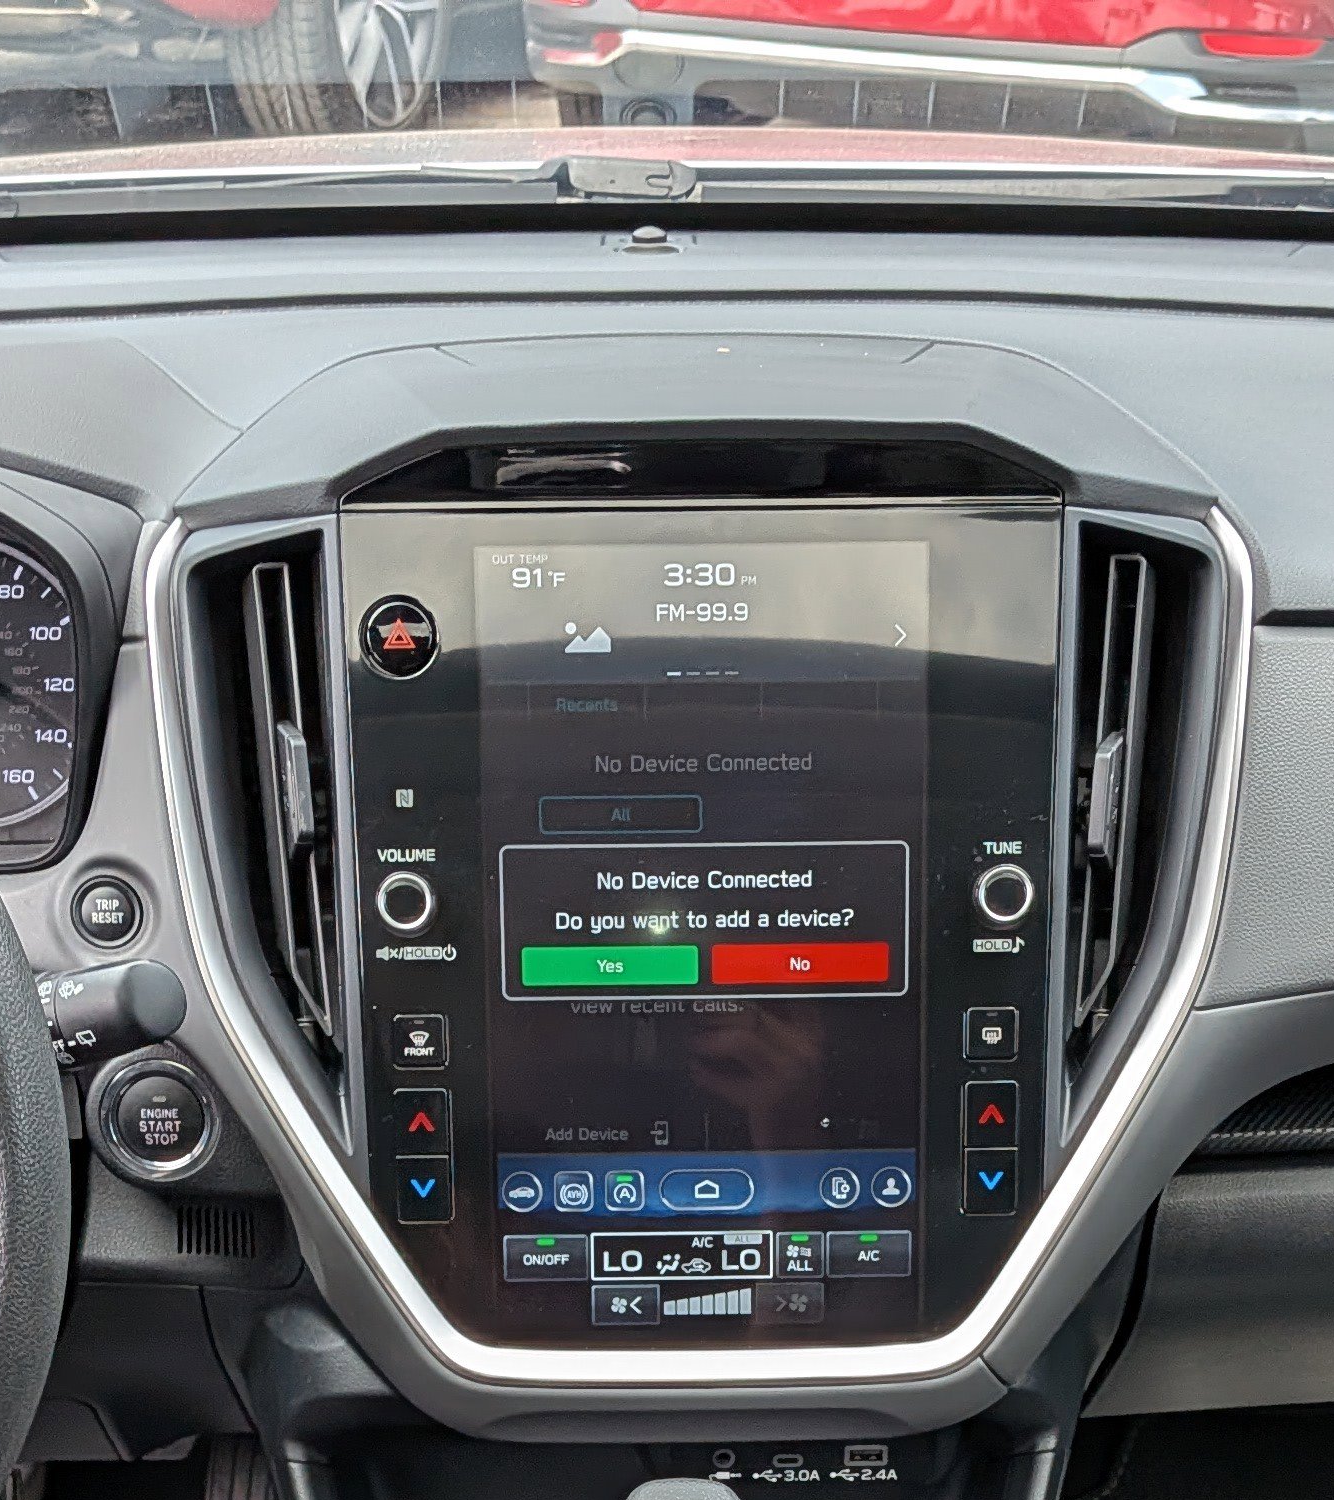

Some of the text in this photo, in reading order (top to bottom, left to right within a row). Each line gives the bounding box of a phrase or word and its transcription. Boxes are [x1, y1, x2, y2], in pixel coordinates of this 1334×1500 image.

[492, 553, 548, 565] OUT TEMP
[511, 568, 566, 589] 91°F
[663, 562, 757, 588] 3:30 PM
[655, 602, 749, 623] FM-99.9
[29, 627, 62, 641] 100
[43, 677, 76, 693] 120
[555, 697, 618, 712] Recents
[34, 729, 68, 744] 140
[595, 752, 812, 772] No Device Connected
[2, 769, 35, 784] 160
[610, 808, 631, 823] All
[983, 841, 1023, 855] TUNE
[377, 849, 436, 862] VOLUME
[596, 869, 813, 890] No Device Connected
[95, 898, 120, 911] TRIP
[91, 911, 124, 925] RESET
[555, 908, 854, 934] Do you want to add a device?
[404, 947, 442, 959] HOLD
[974, 940, 1011, 952] HOLD
[596, 960, 624, 973] Yes
[789, 957, 811, 971] No
[403, 1046, 435, 1058] FRONT
[140, 1107, 179, 1119] ENGINE
[139, 1120, 181, 1132] START
[144, 1133, 179, 1146] STOP
[544, 1127, 629, 1142] Add Device
[691, 1236, 714, 1248] A/C
[522, 1253, 570, 1266] ON/OFF
[603, 1250, 643, 1272] LO
[721, 1248, 761, 1271] LO
[857, 1250, 881, 1262] A/C
[786, 1260, 814, 1272] ALL
[783, 1469, 821, 1482] 3.0A
[860, 1468, 898, 1482] 2.4A
